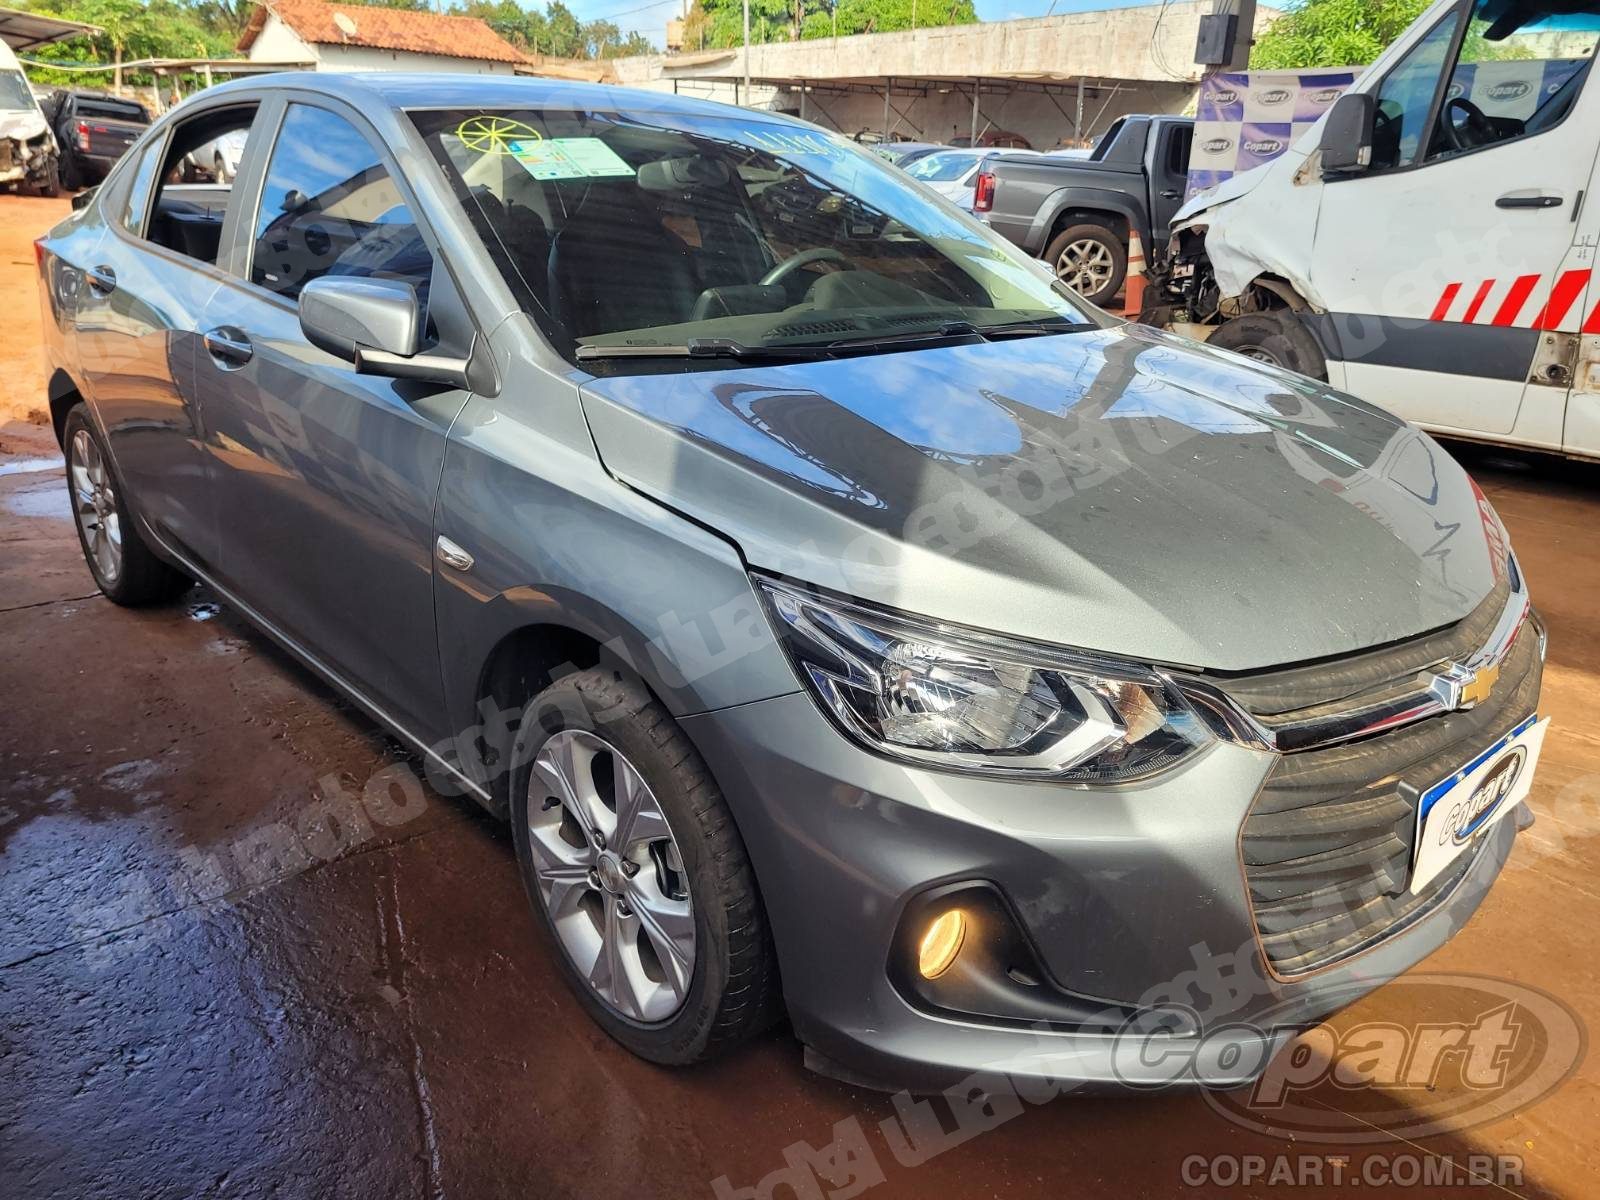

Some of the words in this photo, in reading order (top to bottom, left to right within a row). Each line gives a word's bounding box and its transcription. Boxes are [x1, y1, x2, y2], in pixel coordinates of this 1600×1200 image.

[1203, 91, 1235, 102] Copart
[1244, 142, 1277, 151] Copart
[1439, 753, 1520, 846] Copart
